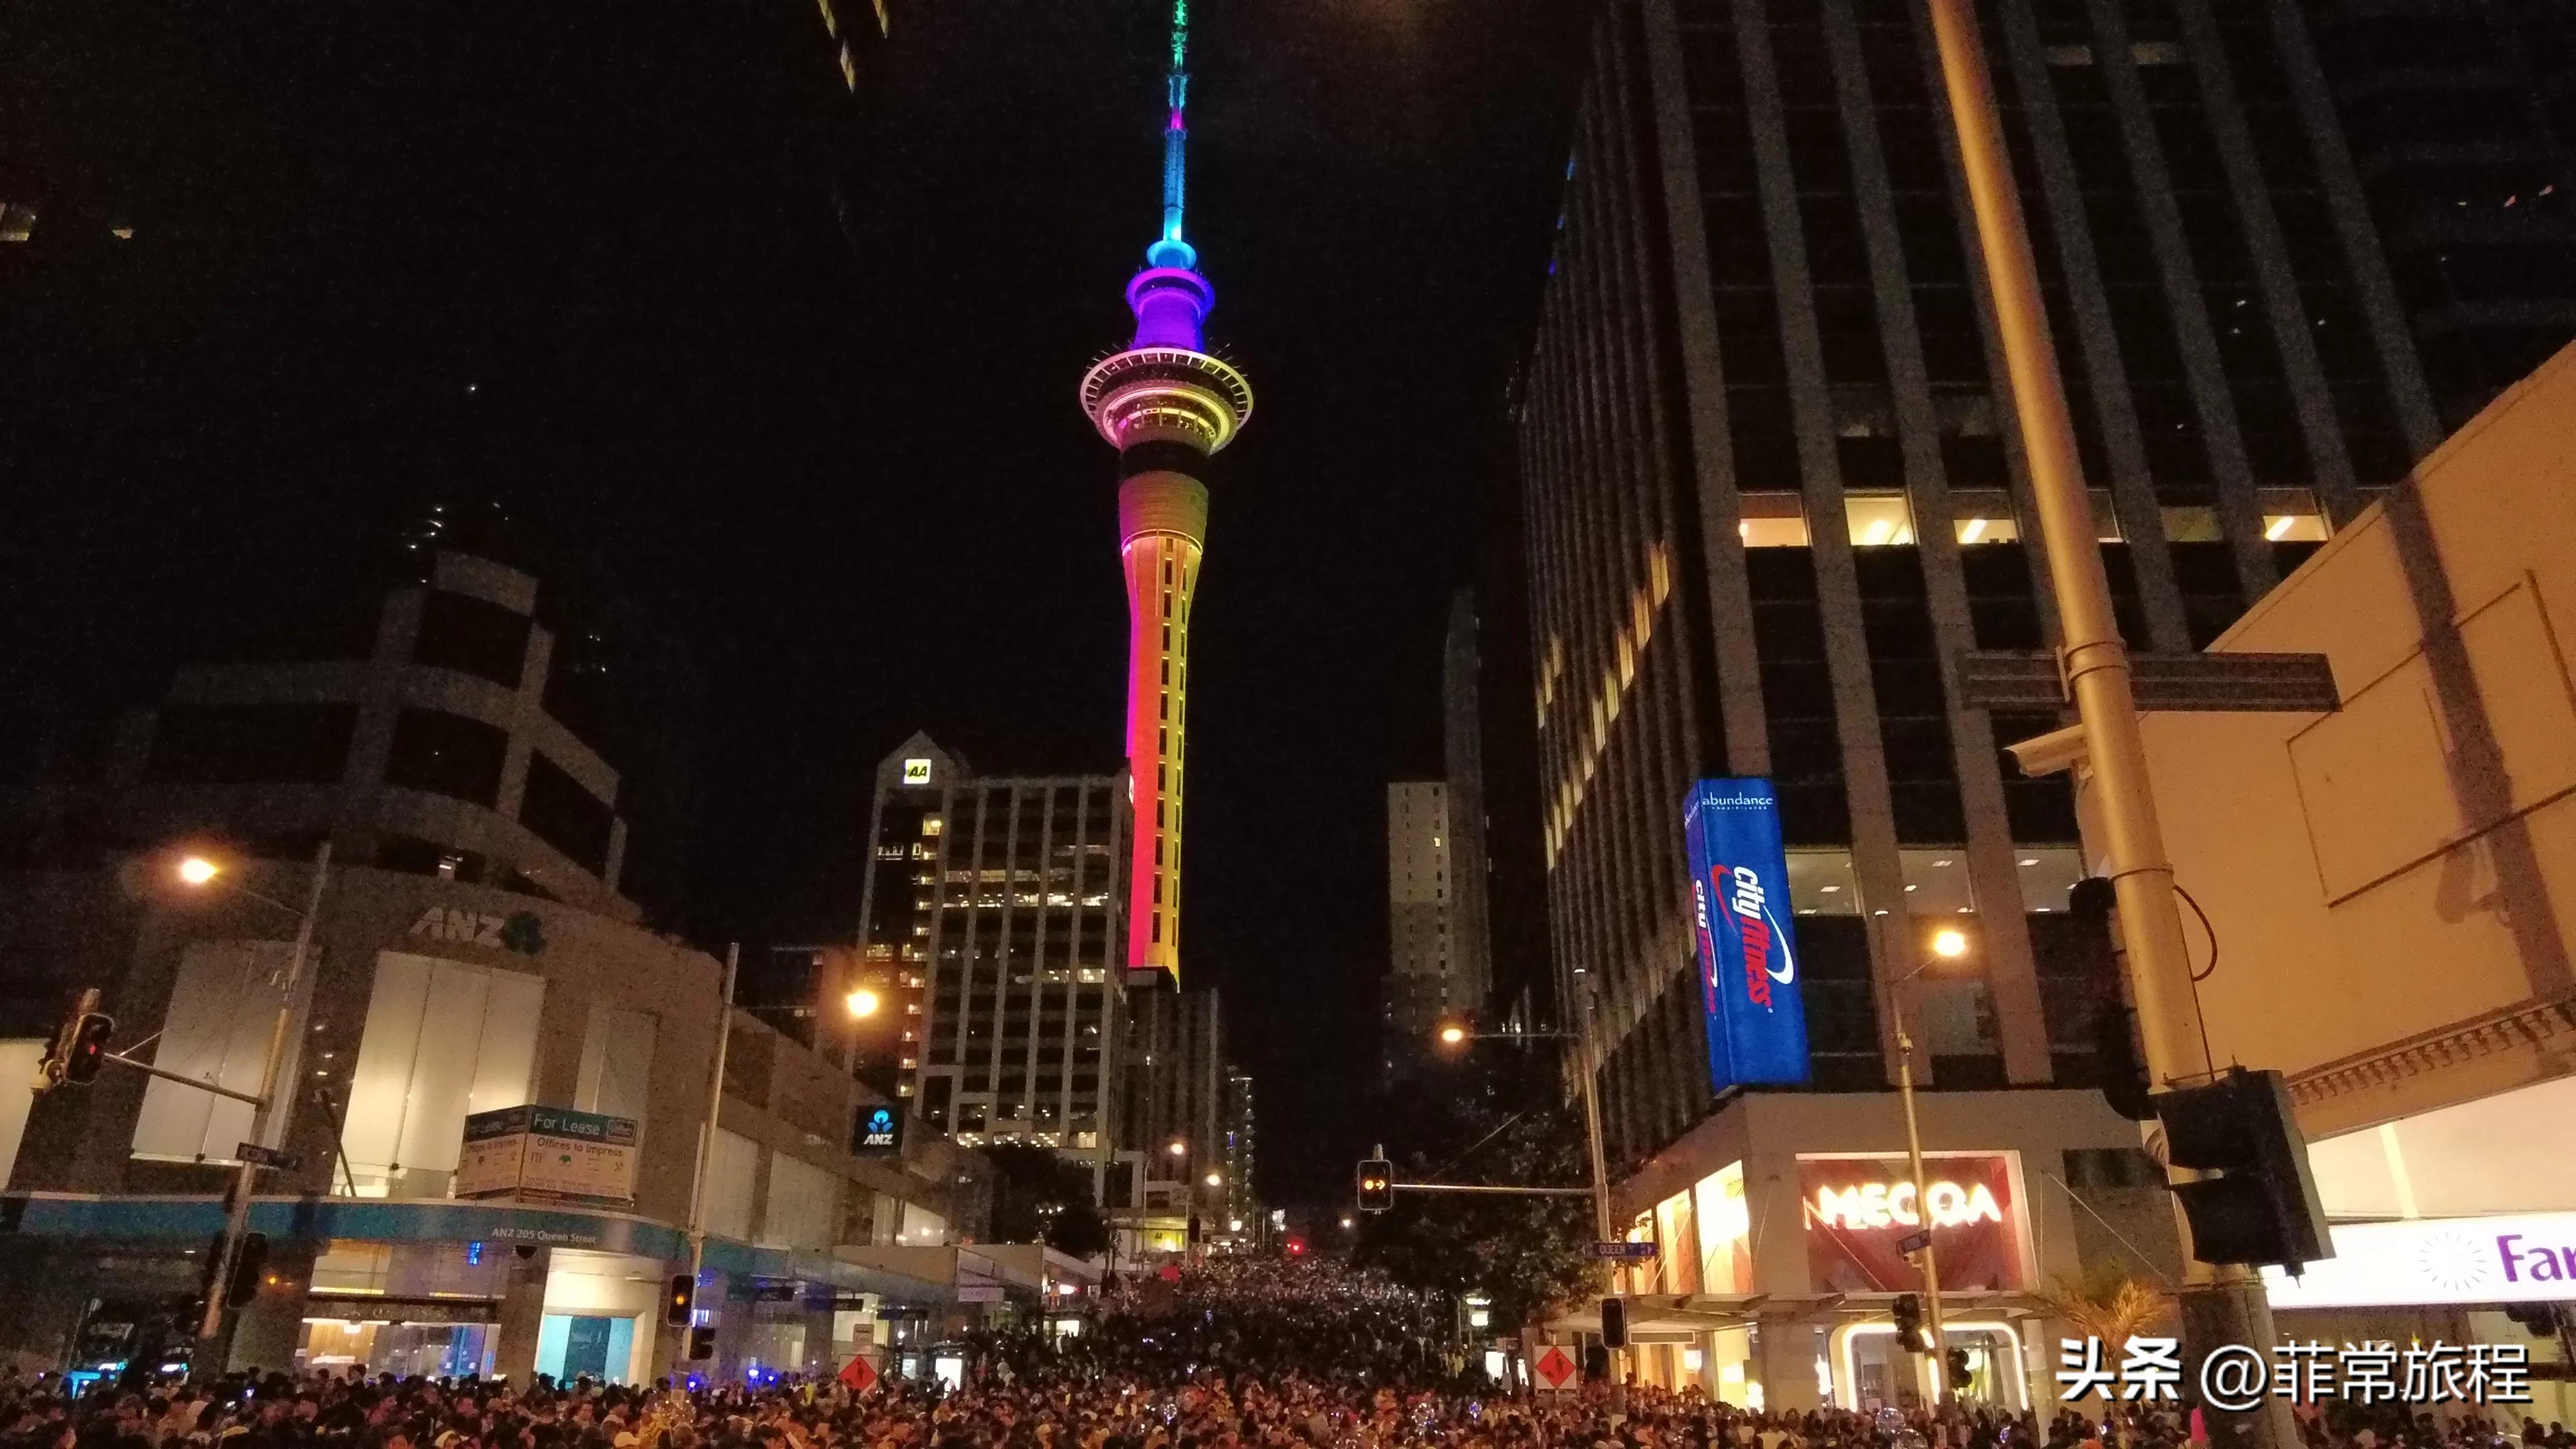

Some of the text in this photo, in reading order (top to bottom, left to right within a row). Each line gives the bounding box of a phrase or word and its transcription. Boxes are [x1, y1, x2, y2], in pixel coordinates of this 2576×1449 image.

[908, 766, 927, 777] AA
[1702, 792, 1773, 805] abundance
[410, 906, 505, 948] ANZ
[534, 1113, 557, 1129] For
[562, 1118, 602, 1135] Lease
[863, 1134, 893, 1145] ANZ
[574, 1143, 583, 1152] to
[585, 1147, 623, 1157] Impress
[492, 1228, 596, 1244] ANZ 205 Queen Street
[1599, 1244, 1626, 1255] QUEEN
